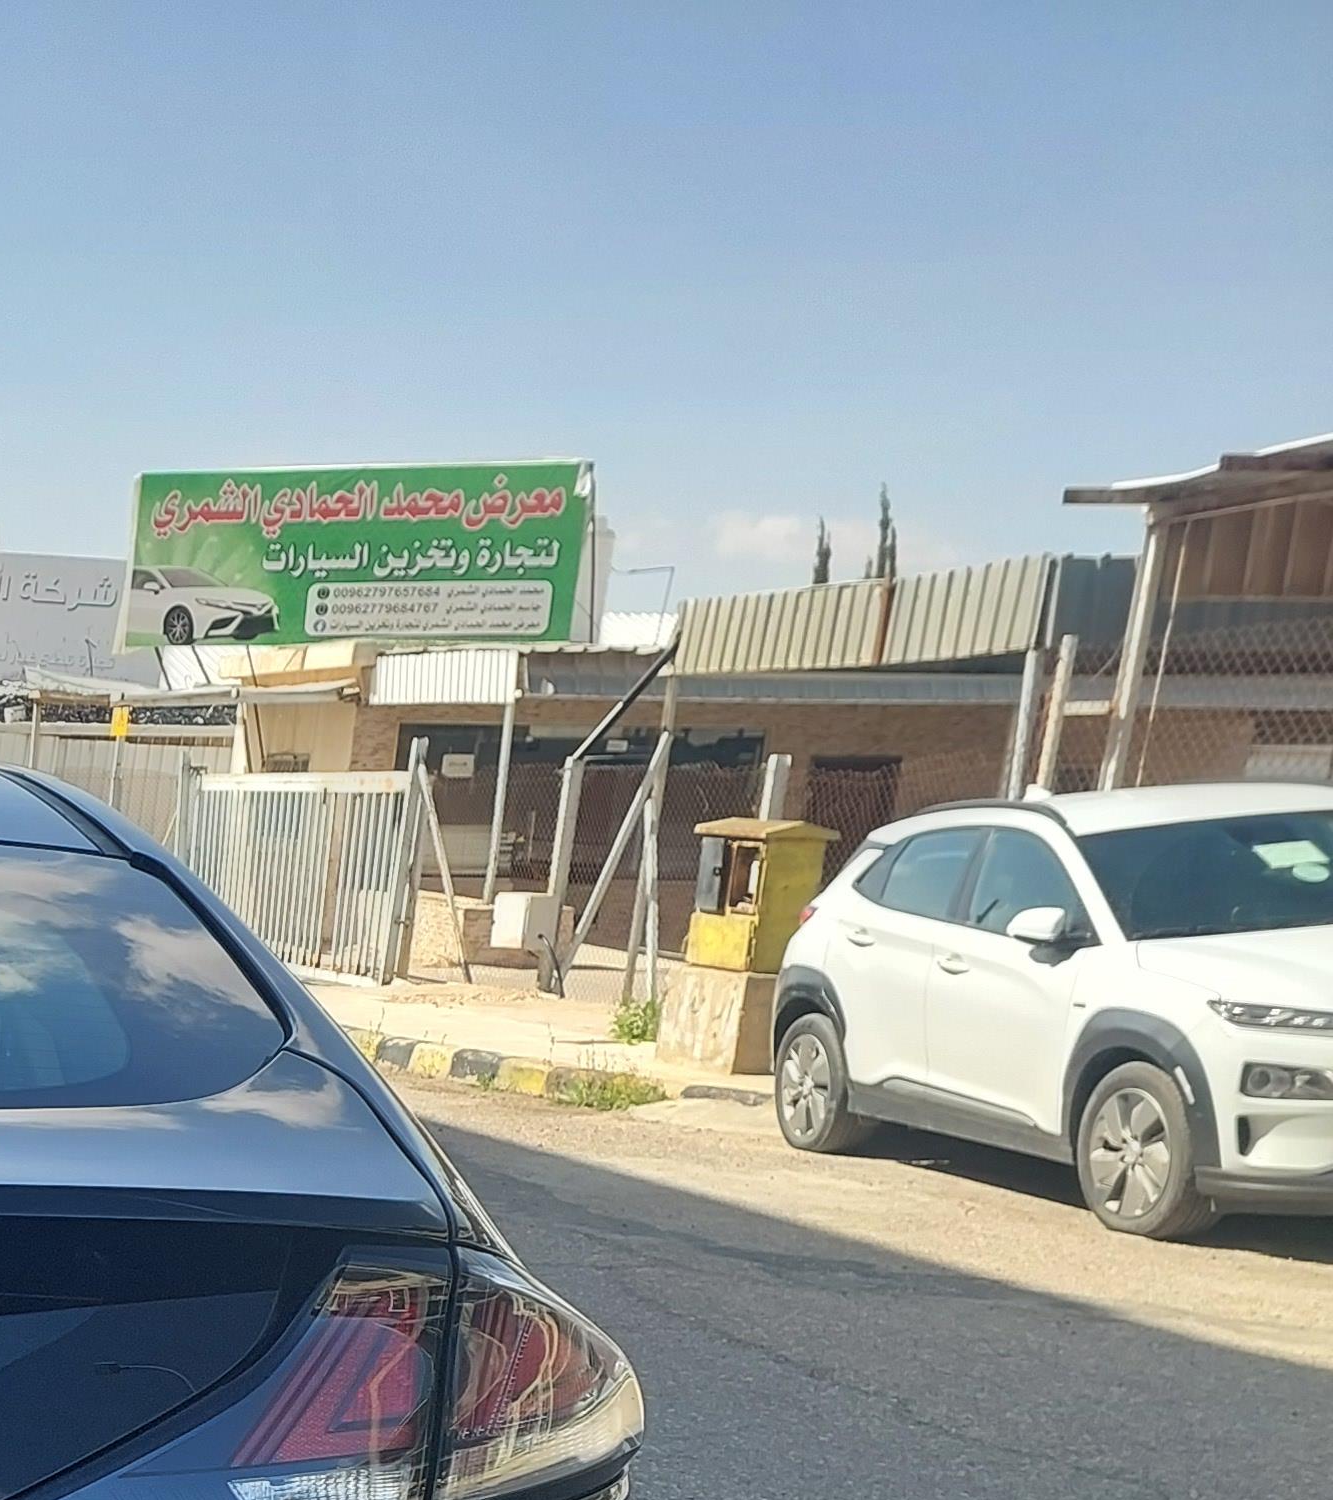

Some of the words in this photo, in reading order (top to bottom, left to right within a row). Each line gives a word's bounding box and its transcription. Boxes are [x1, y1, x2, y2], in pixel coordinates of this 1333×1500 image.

[151, 477, 260, 538] الشمري
[260, 480, 375, 538] الحمادي
[380, 482, 463, 521] محمد
[461, 473, 566, 529] معرض
[262, 541, 370, 578] السيارات
[373, 540, 471, 578] وتخزين
[476, 536, 561, 577] لتجارة
[20, 573, 119, 611] شركة
